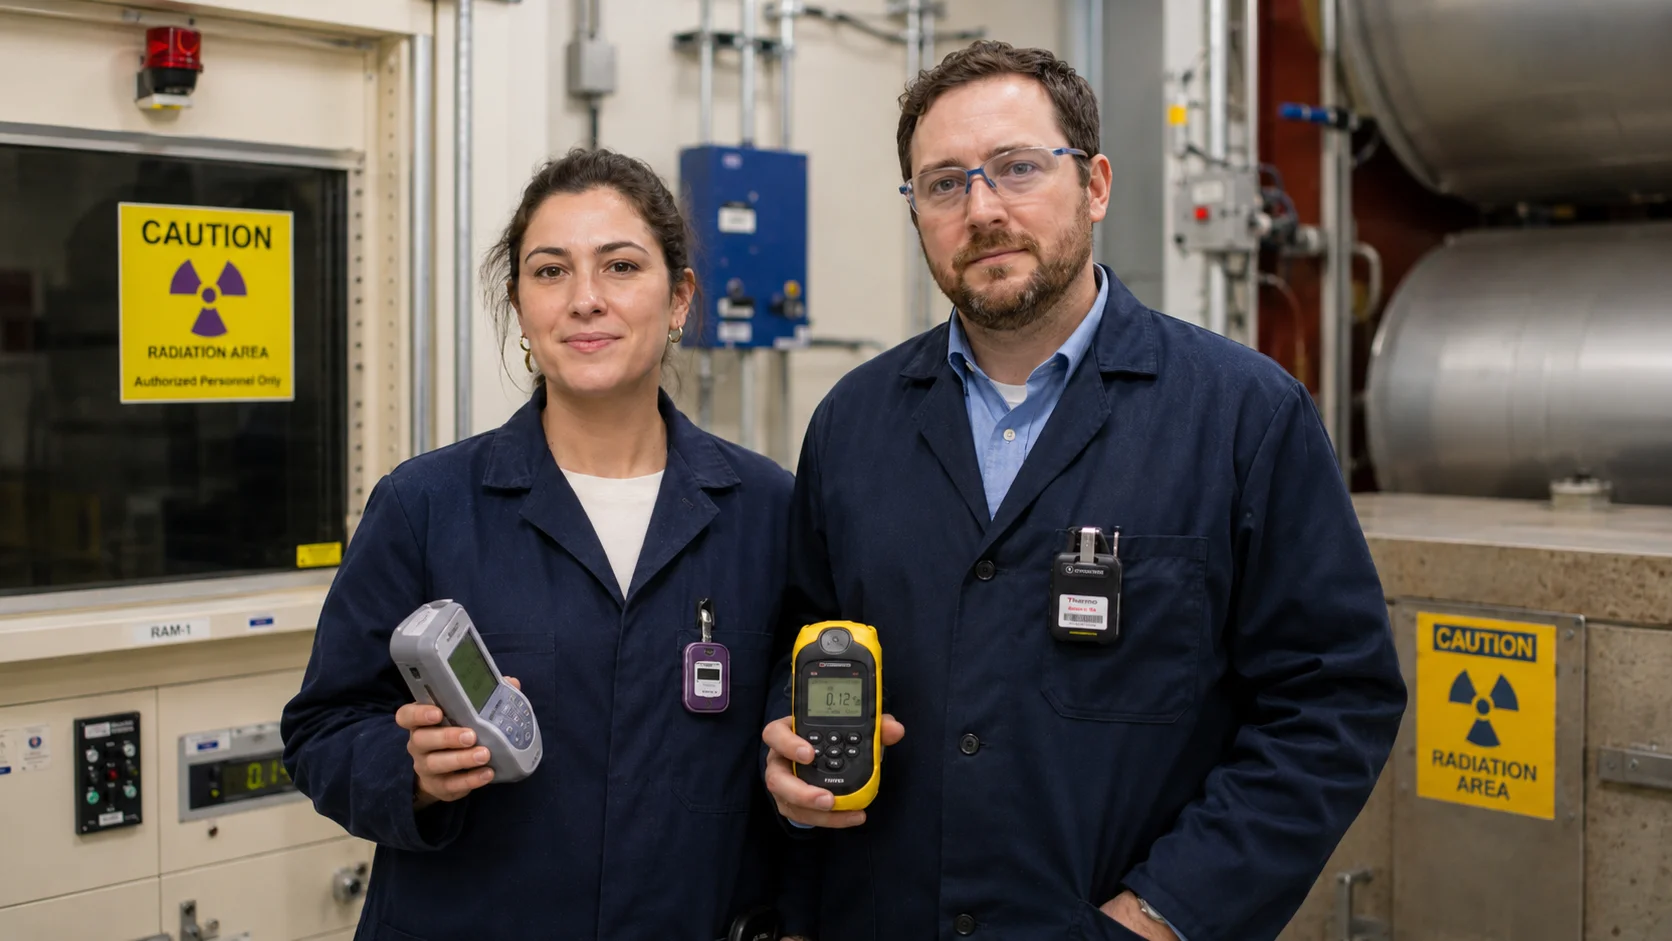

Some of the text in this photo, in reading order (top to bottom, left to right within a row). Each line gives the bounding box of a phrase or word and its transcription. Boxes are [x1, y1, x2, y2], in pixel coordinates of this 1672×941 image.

[141, 220, 272, 249] CAUTION
[148, 346, 269, 359] RADIATION AREA
[134, 374, 281, 388] Authorized Personnel Only
[151, 624, 191, 638] RAM-1
[1435, 627, 1534, 659] CAUTION
[826, 692, 851, 706] 0.12
[1432, 749, 1537, 781] RADIATION
[1456, 776, 1510, 800] AREA
